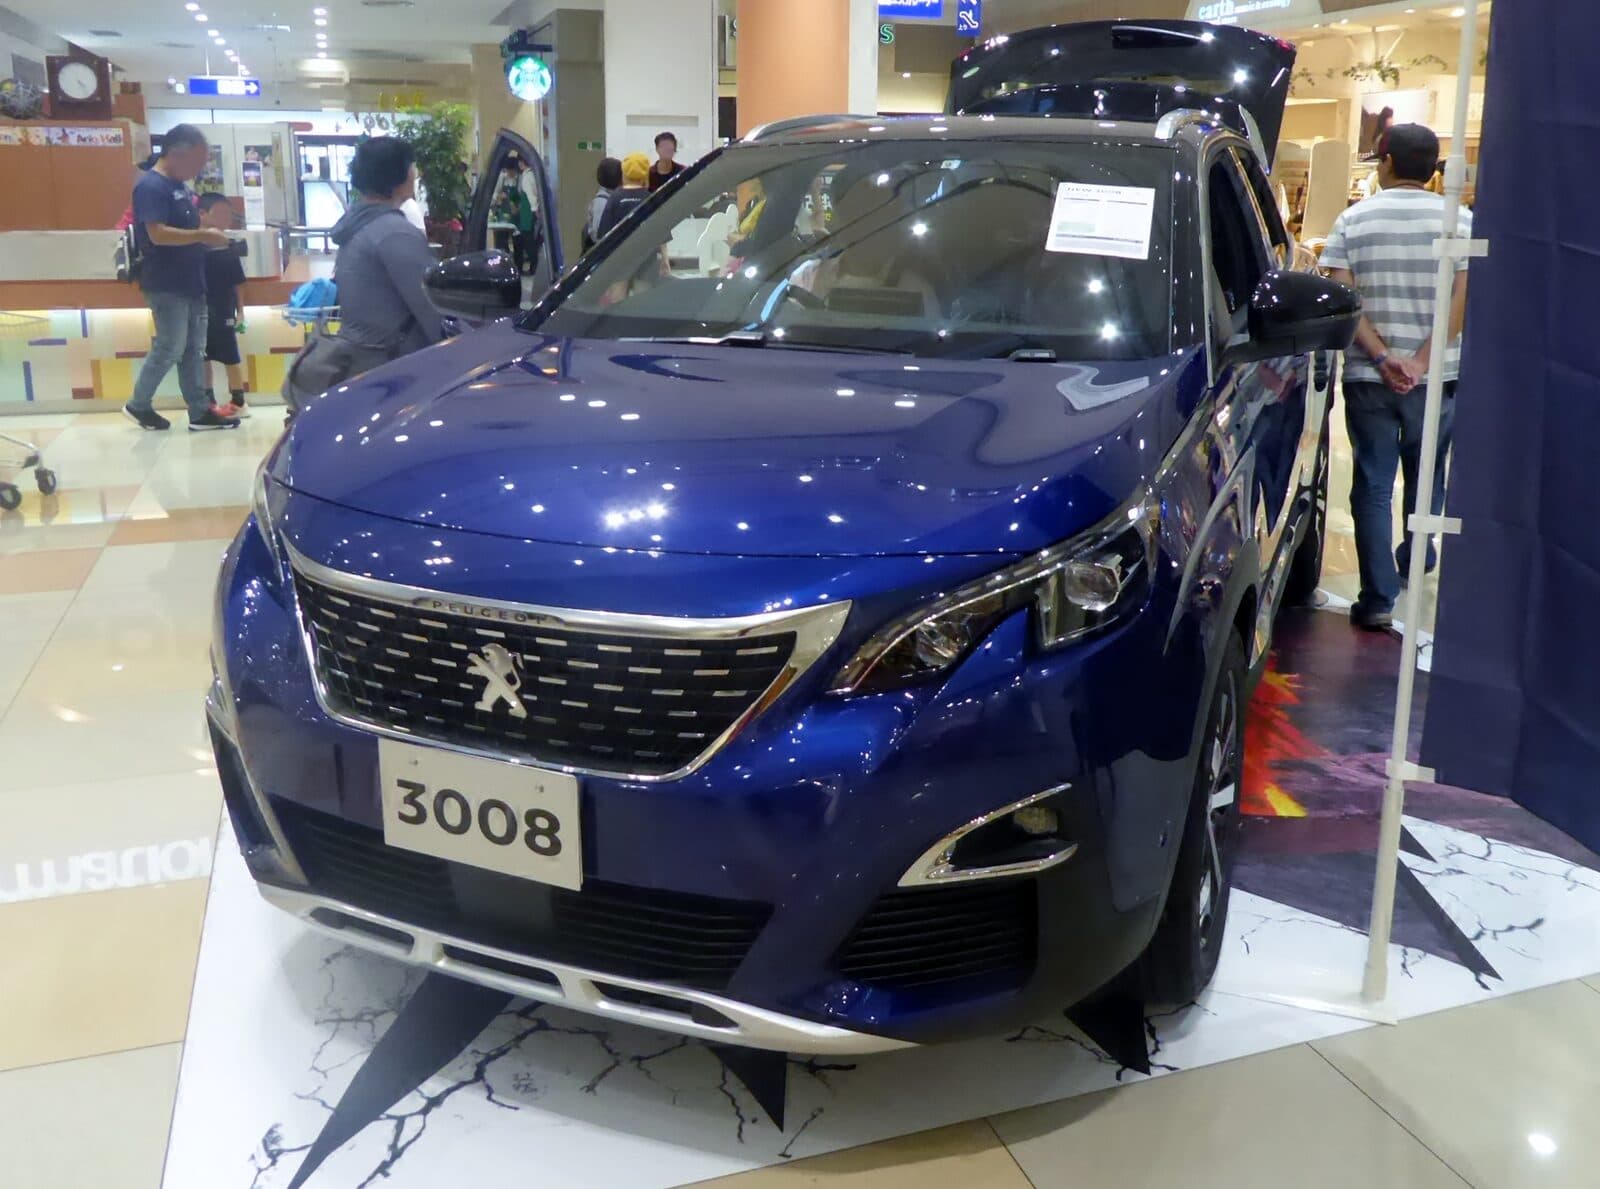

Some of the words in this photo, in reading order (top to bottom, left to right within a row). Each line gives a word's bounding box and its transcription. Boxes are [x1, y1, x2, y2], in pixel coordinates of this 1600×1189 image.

[1199, 0, 1235, 20] earth
[432, 600, 547, 625] PEUGEOT
[396, 778, 563, 857] 3008
